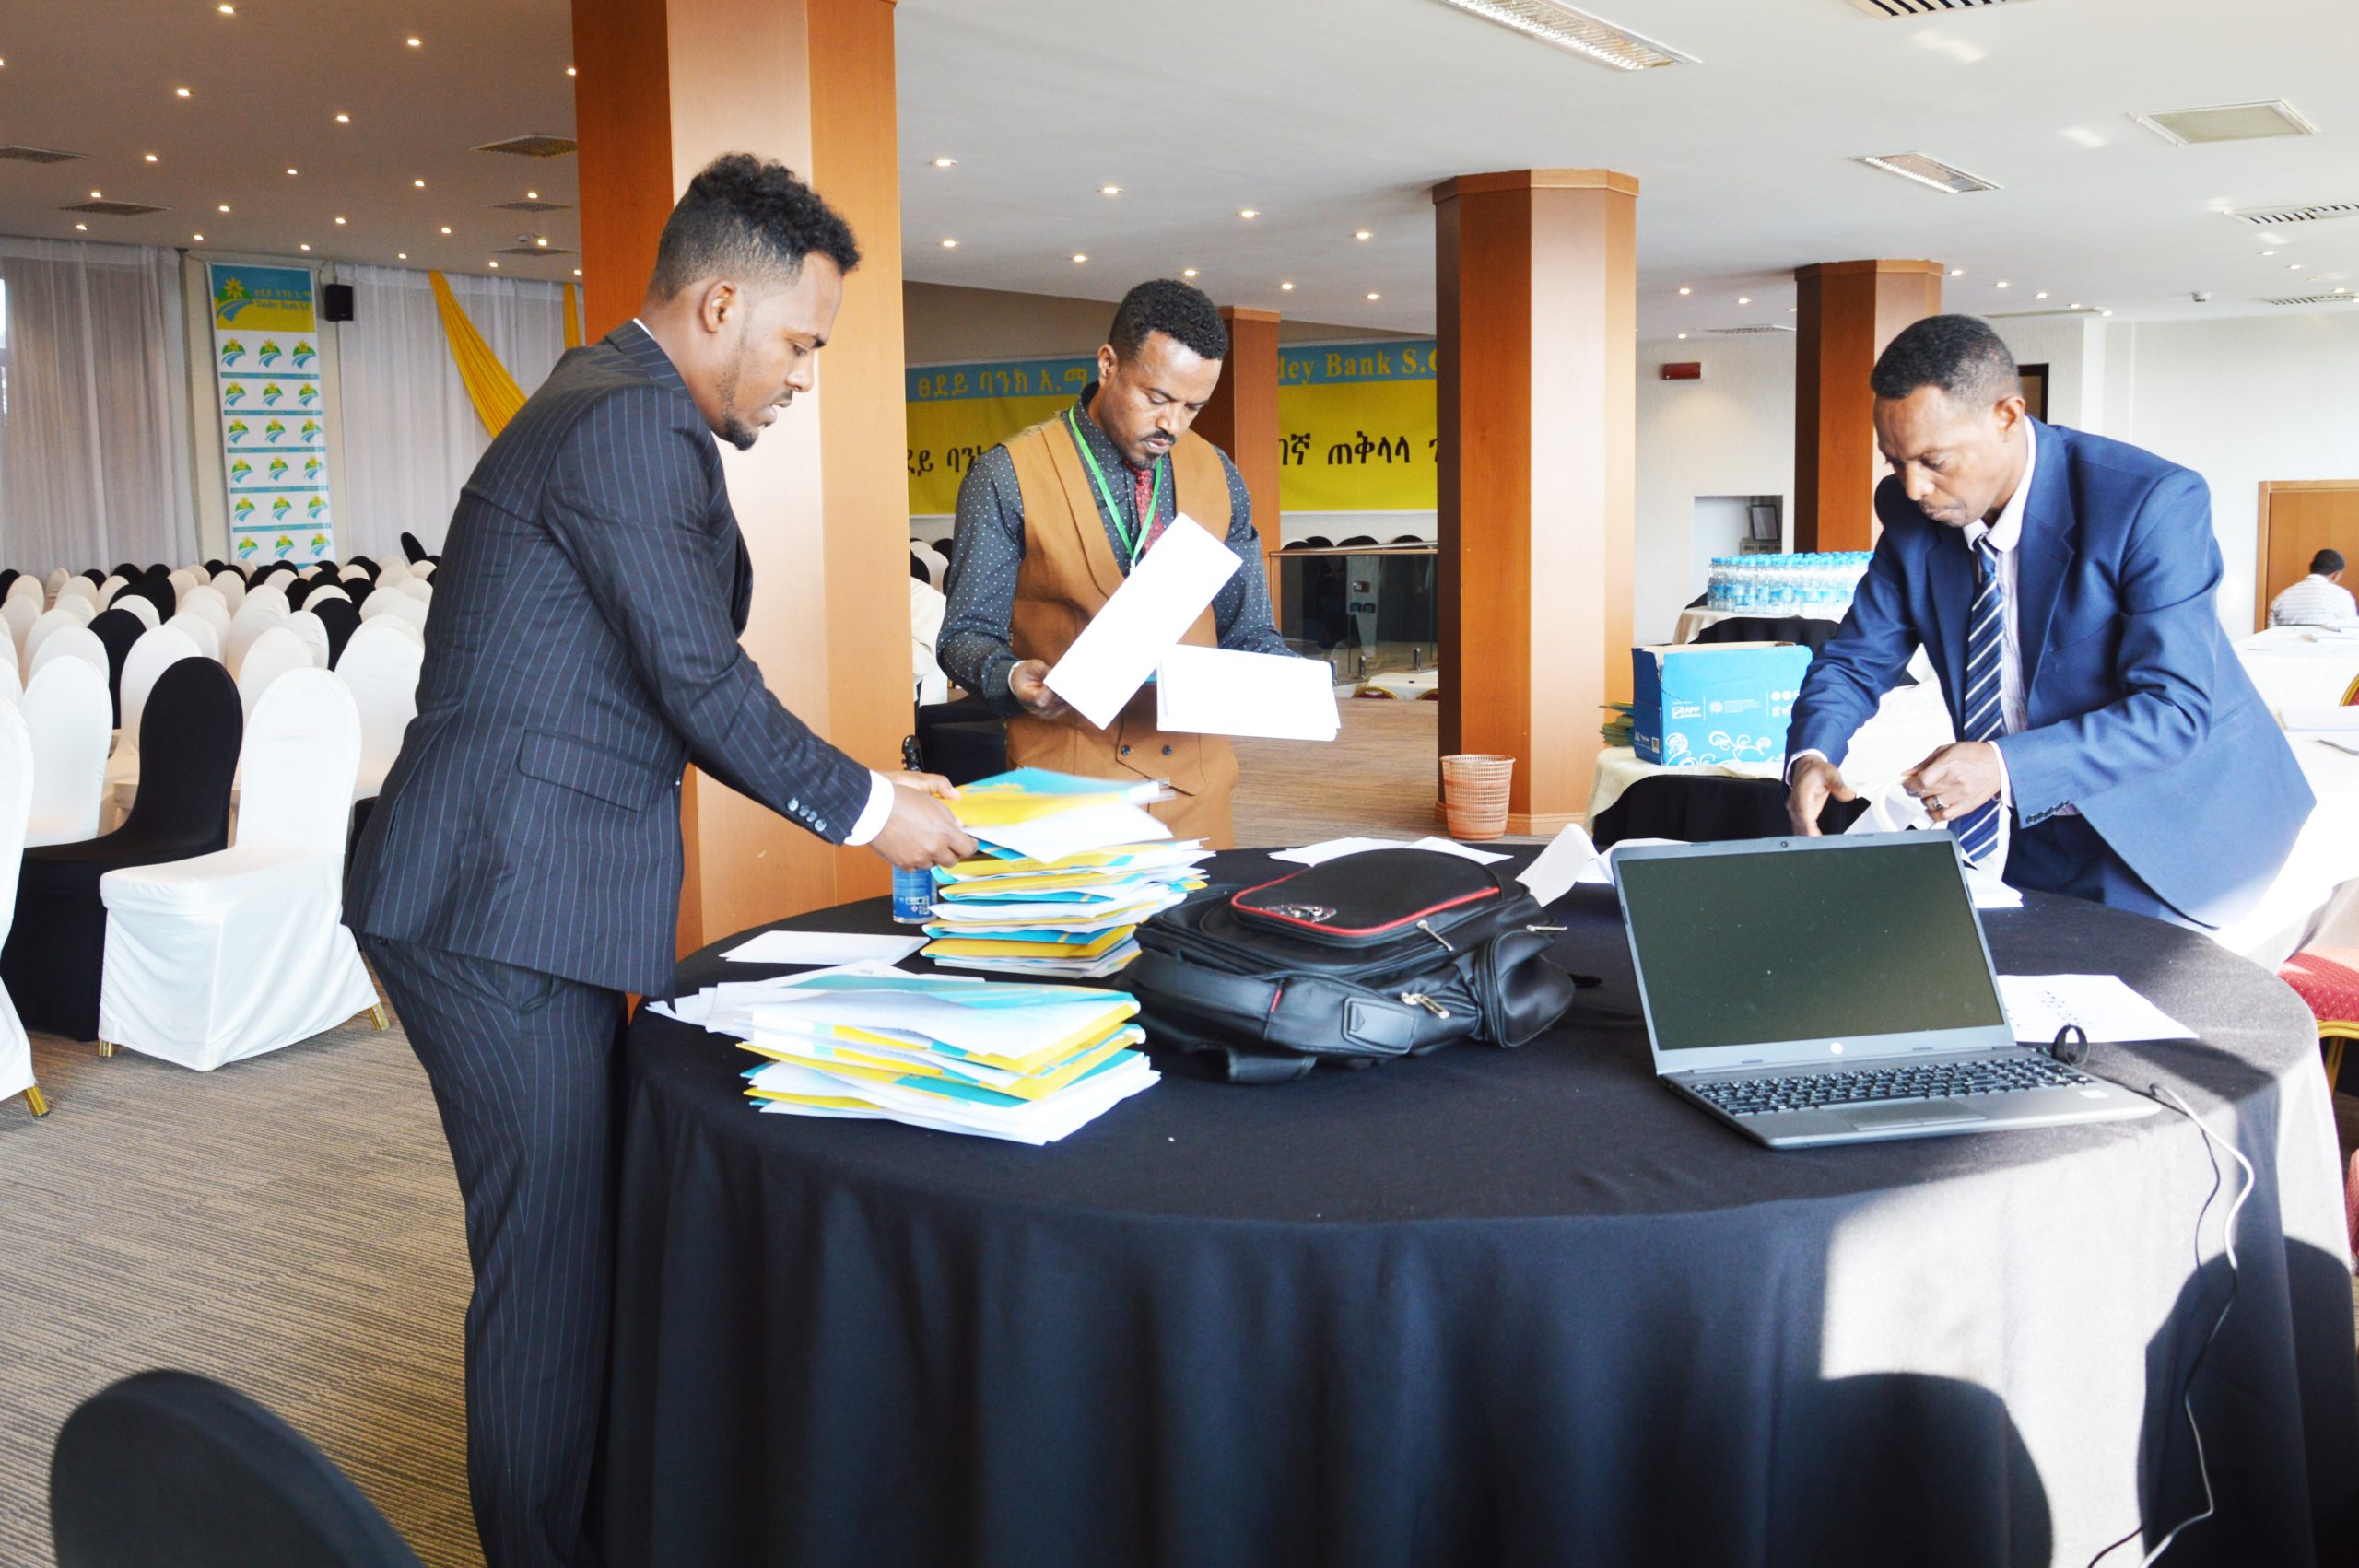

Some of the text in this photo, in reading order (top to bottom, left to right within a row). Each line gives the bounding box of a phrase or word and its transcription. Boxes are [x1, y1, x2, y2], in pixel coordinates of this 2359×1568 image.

[1326, 350, 1392, 378] Bank
[918, 372, 968, 398] ፀደይ
[980, 369, 1029, 394] ባንክ
[1328, 430, 1411, 465] ጠቅላላ
